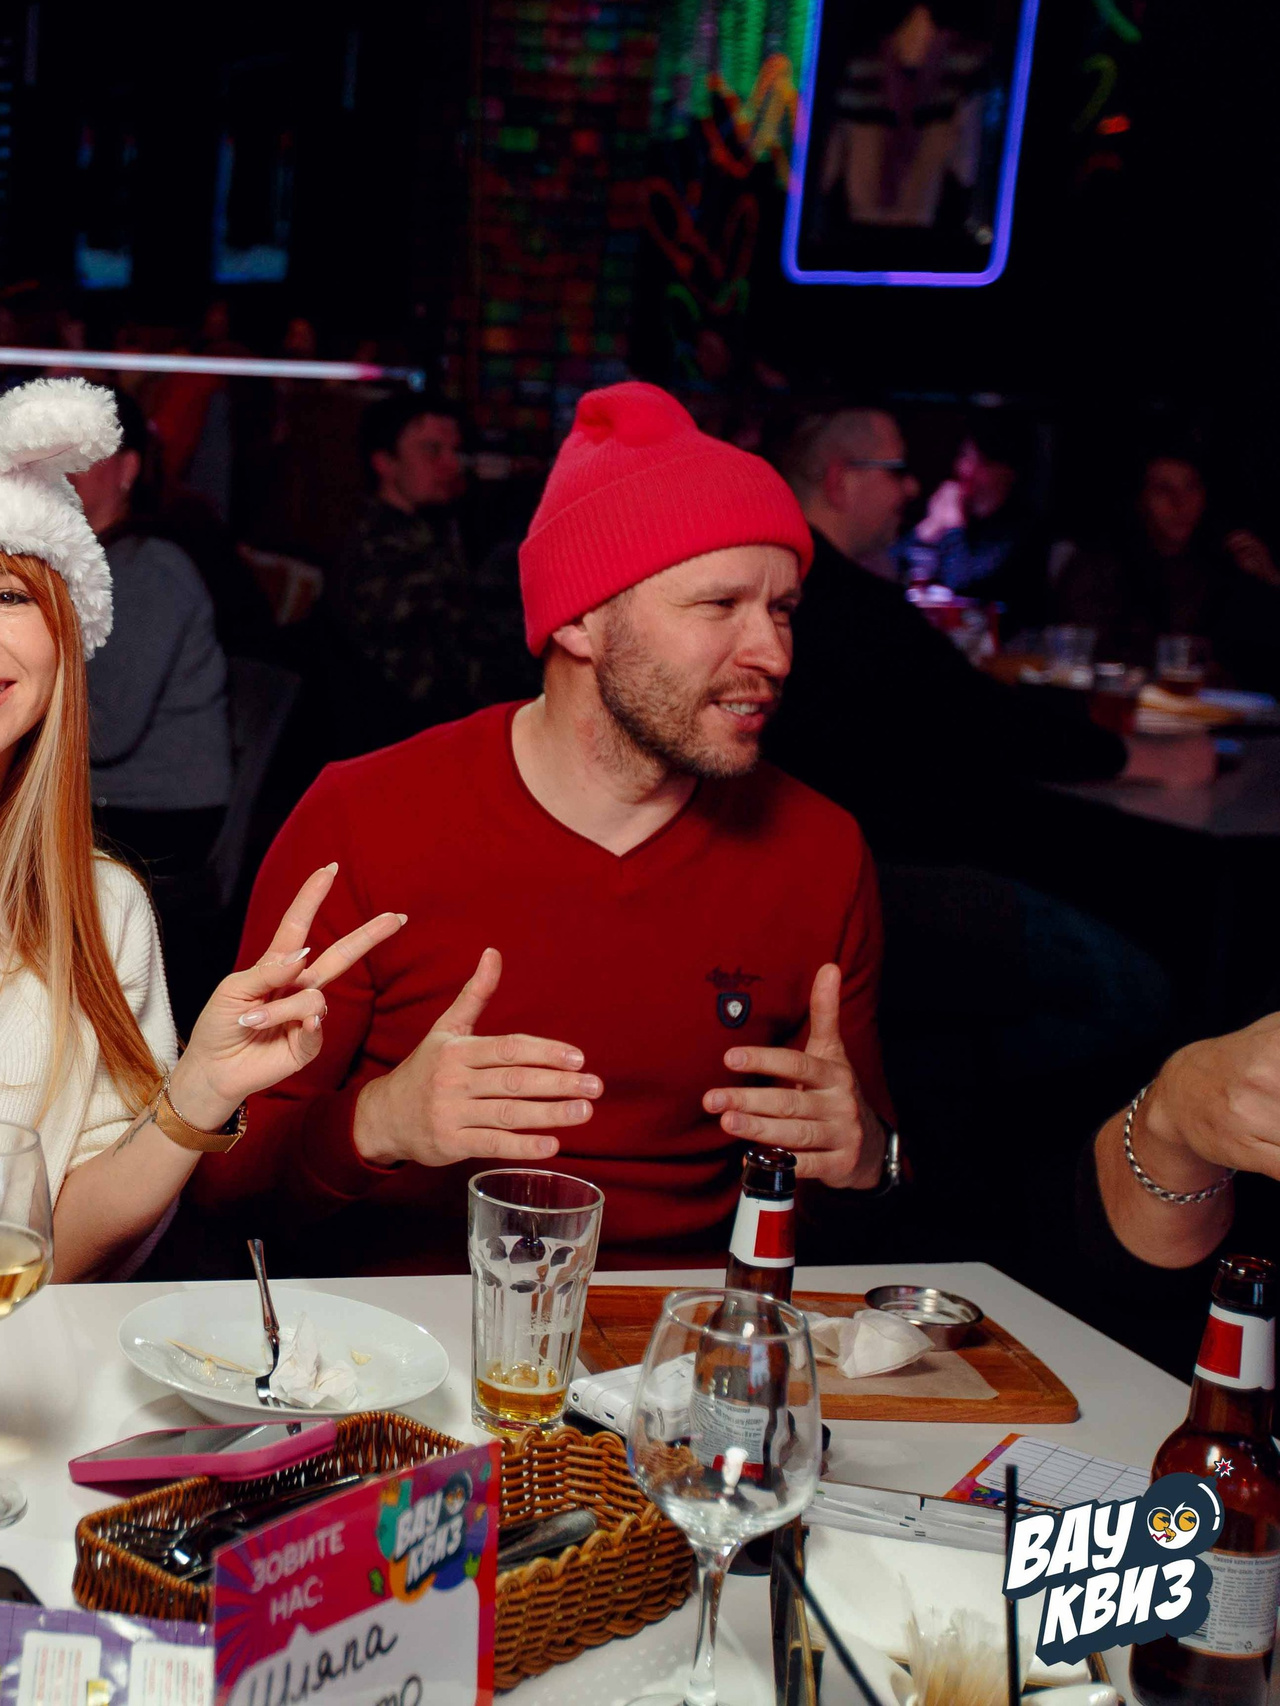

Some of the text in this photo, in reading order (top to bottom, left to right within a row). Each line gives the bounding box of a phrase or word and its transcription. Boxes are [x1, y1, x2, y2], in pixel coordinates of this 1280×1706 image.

[251, 1520, 346, 1594] ЗОВИТЕ
[394, 1490, 443, 1559] ВАУ
[406, 1515, 463, 1587] КВИЗ
[269, 1574, 324, 1626] НАС
